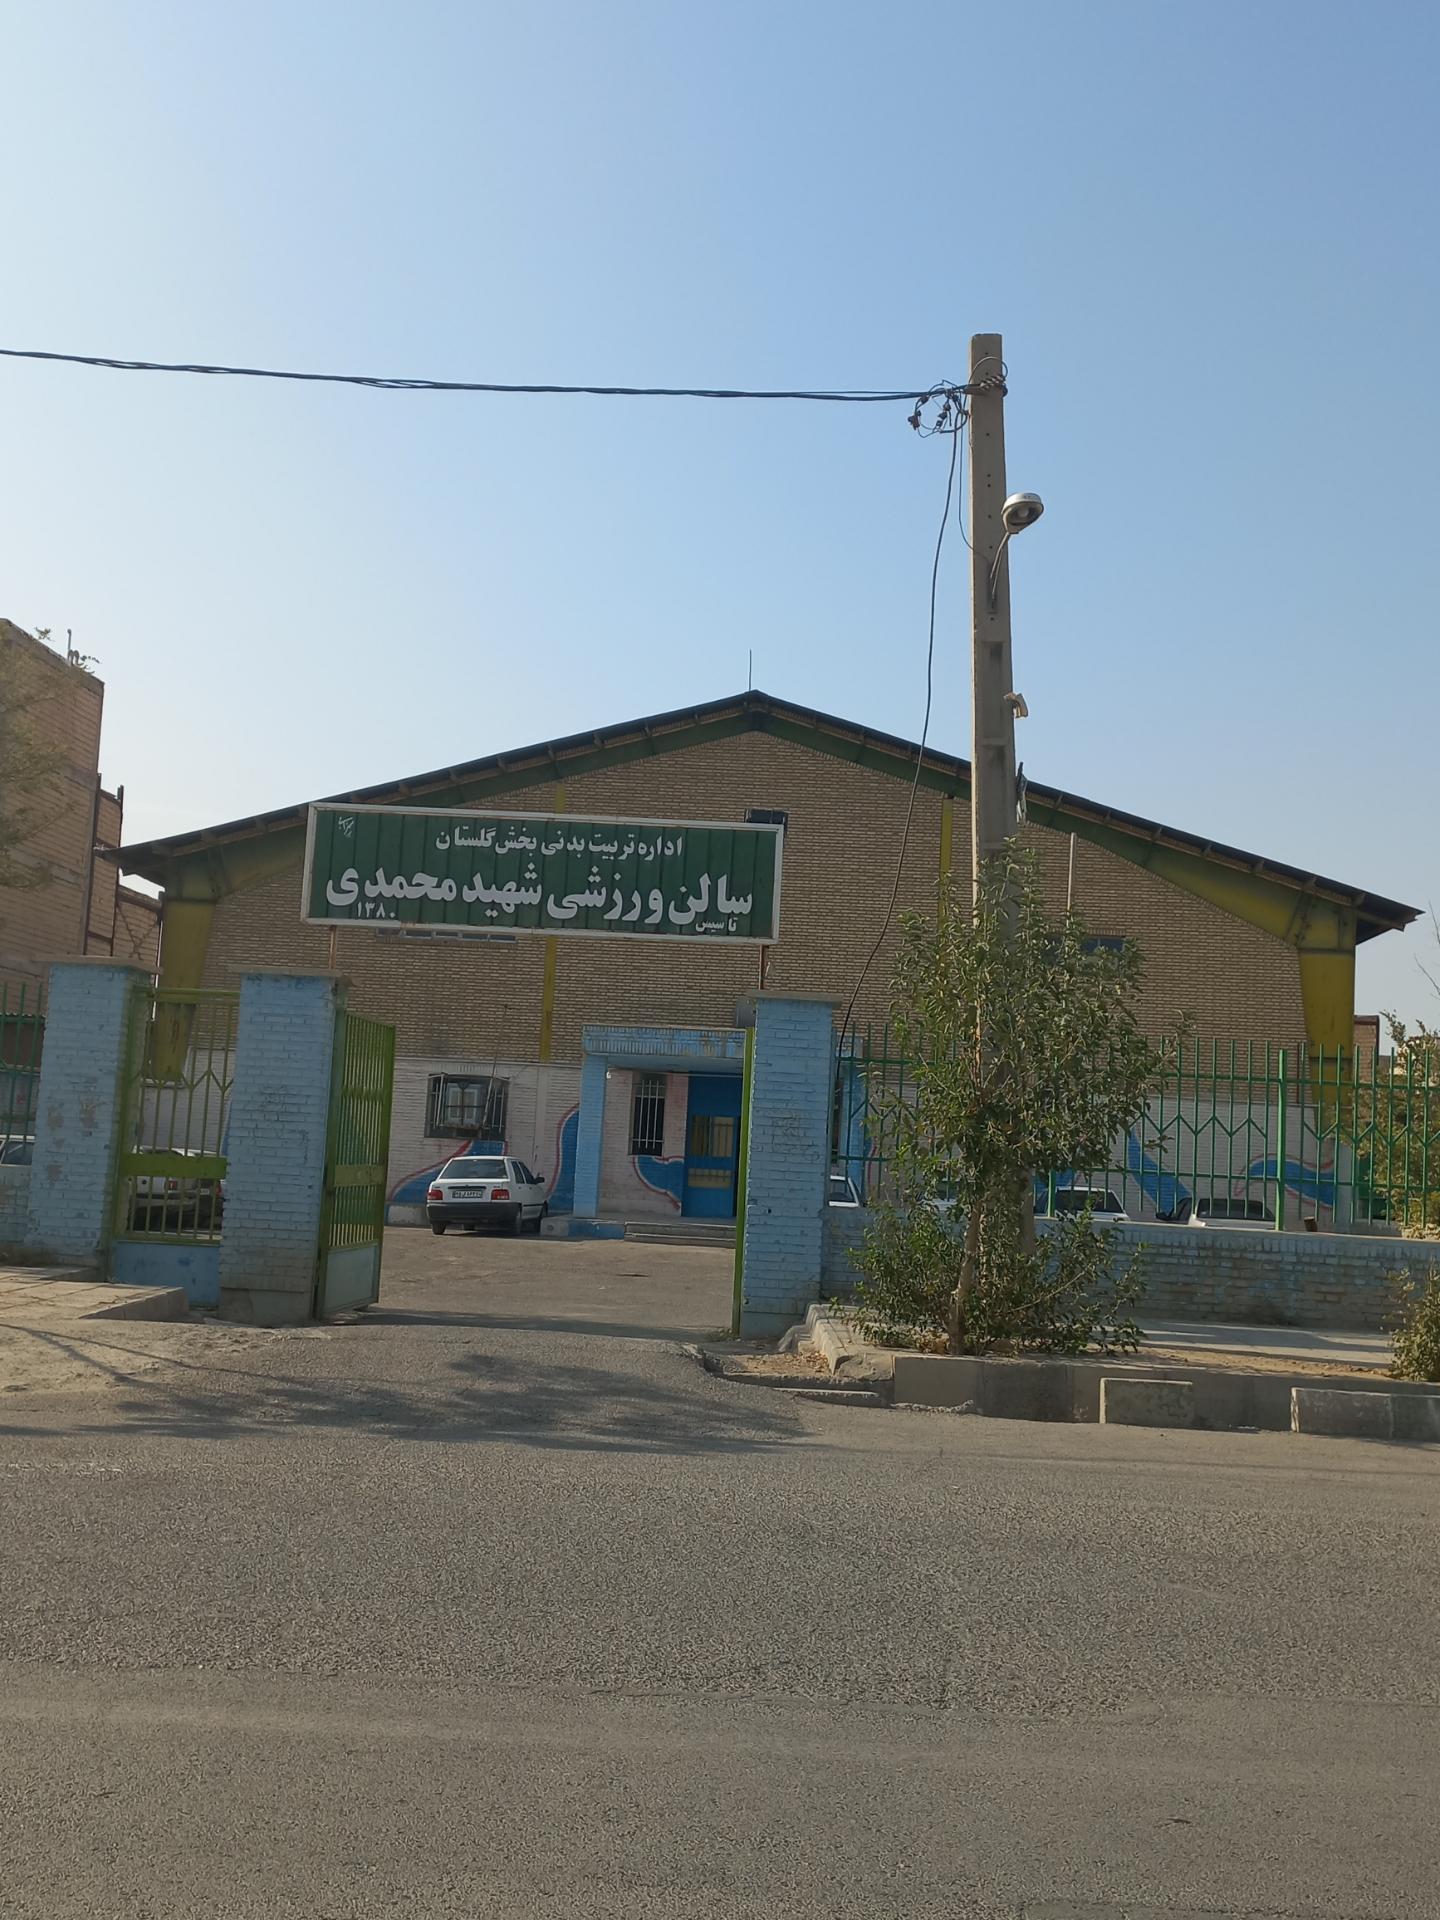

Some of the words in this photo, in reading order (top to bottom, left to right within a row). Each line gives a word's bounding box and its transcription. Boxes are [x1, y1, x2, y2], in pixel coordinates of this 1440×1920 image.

[435, 825, 497, 850] گلستان
[495, 826, 538, 857] بخش
[541, 830, 585, 858] بدنی
[588, 833, 635, 861] تربیت
[638, 836, 683, 862] اداره
[326, 867, 458, 907] محمدی
[462, 861, 543, 919] شهید
[546, 865, 664, 925] ورزشی
[668, 872, 753, 925] سالن
